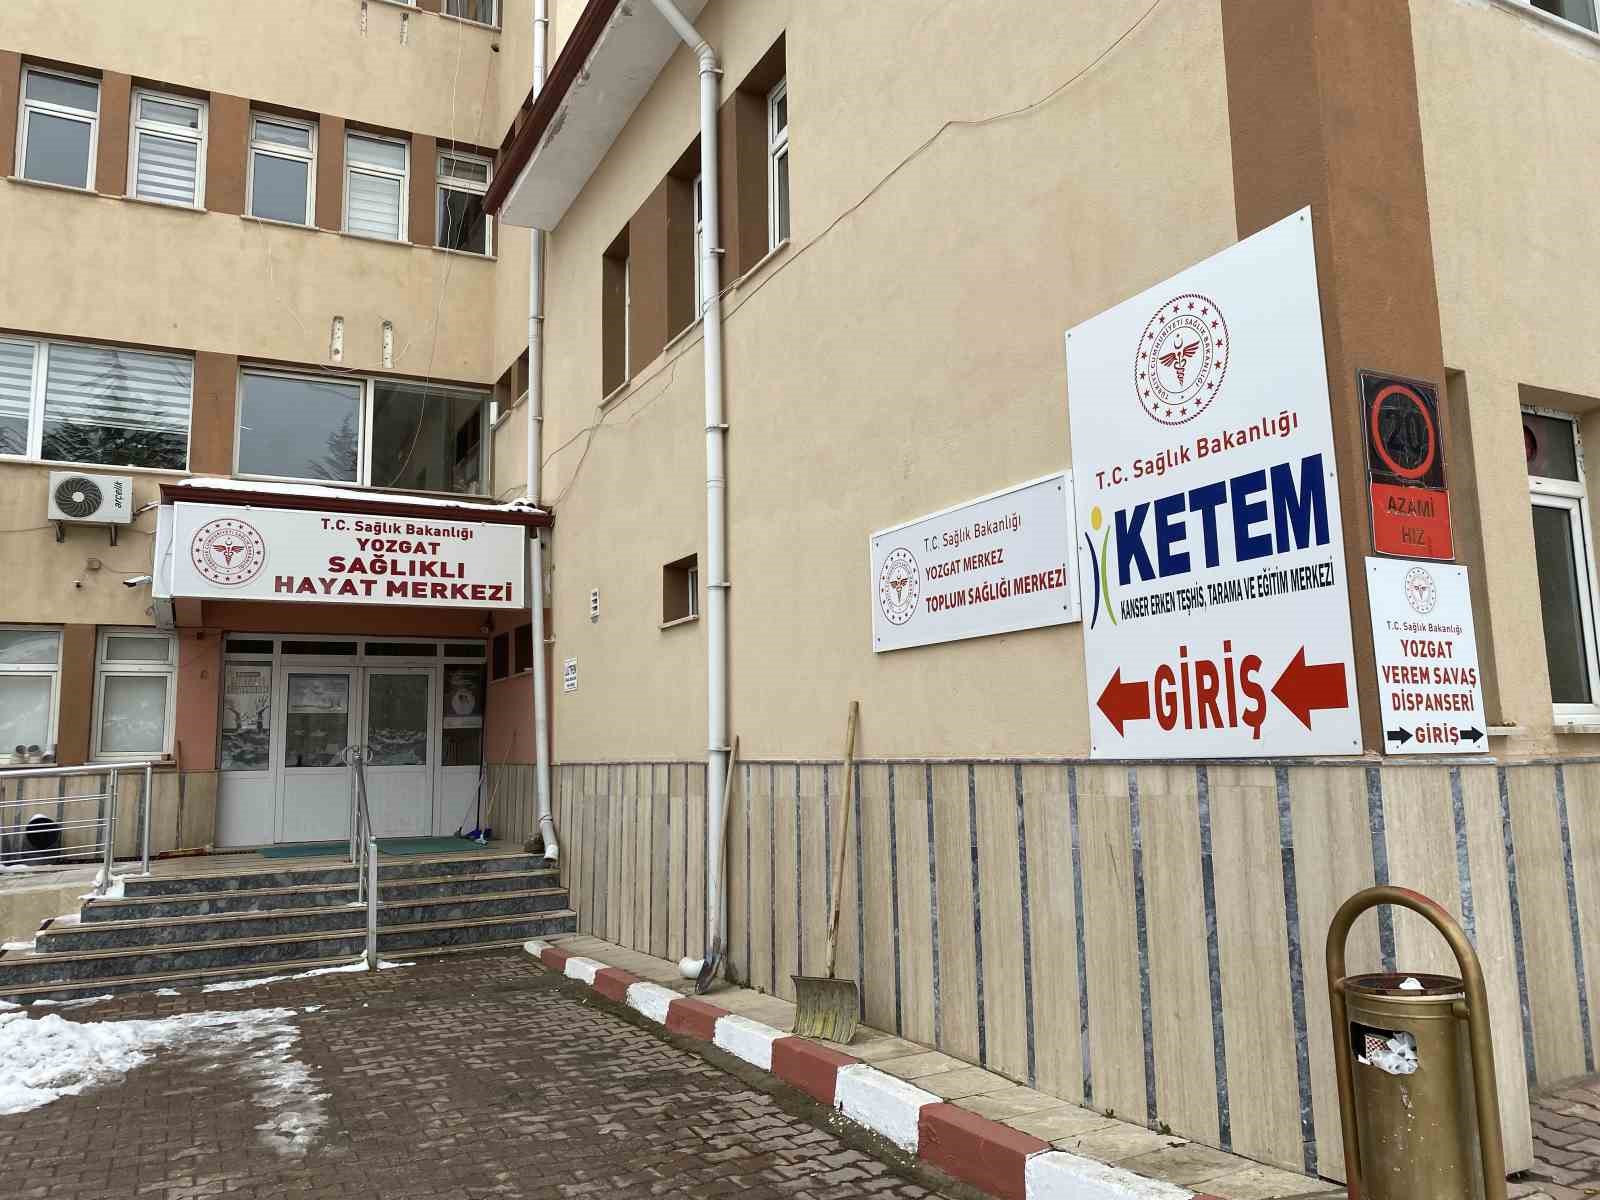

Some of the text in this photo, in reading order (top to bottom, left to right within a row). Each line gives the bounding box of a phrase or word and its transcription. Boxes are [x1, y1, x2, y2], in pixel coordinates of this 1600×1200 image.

[1096, 410, 1298, 490] T.C. Sağlık Bakanlığı
[1387, 495, 1435, 517] AZAMİ
[321, 518, 473, 541] T.C. Sağlık Bakanlığı
[1114, 453, 1330, 586] KETEM
[924, 512, 1021, 552] T.C. Sağlık Bakanlığı
[1401, 527, 1426, 546] HIZ
[357, 538, 440, 555] YOZGAT
[328, 554, 465, 579] SAĞLIKLI
[925, 549, 1004, 581] YOZGAT MERKEZ
[274, 576, 513, 602] HAYAT MERKEZİ
[926, 563, 1067, 613] TOPLUM SAĞLIĞI MERKEZİ
[1120, 555, 1335, 620] KANSER ERKEN TEŞHİS, TARAMA VE EĞİTİM MERKEZİ
[1386, 620, 1463, 636] T.C. Sağlık Bakanlığı
[1400, 639, 1453, 659] YOZGAT
[1382, 665, 1477, 689] VEREM SAVAŞ
[1154, 639, 1267, 740] GİRİŞ
[1392, 689, 1474, 712] DİSPANSERİ
[1415, 722, 1459, 746] GİRİŞ
